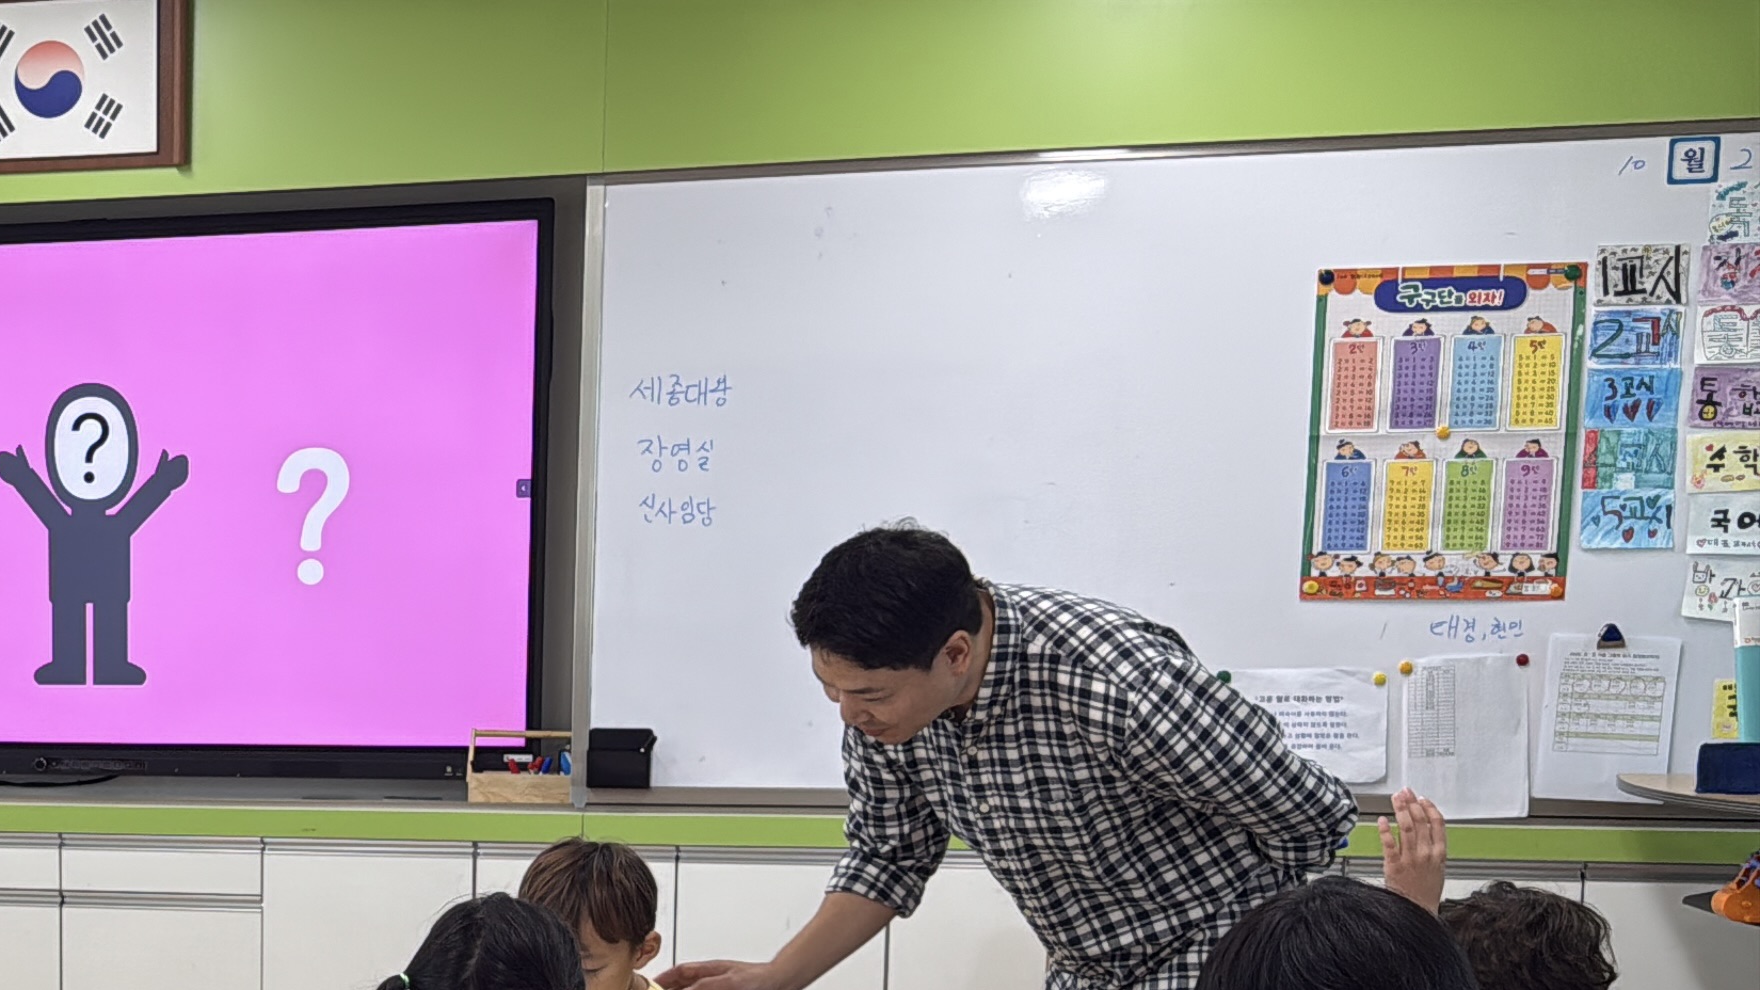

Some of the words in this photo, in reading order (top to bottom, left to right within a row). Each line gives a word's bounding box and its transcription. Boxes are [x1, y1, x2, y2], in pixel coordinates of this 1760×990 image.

[1618, 155, 1646, 176] 10
[1680, 147, 1705, 173] 월
[1602, 245, 1683, 304] 1교시
[1467, 288, 1505, 306] 외자!
[1590, 309, 1683, 359] 2교시
[628, 373, 733, 407] 세종대왕
[637, 435, 714, 473] 장영실
[638, 493, 718, 527] 신사임당
[1600, 495, 1673, 531] 5교시
